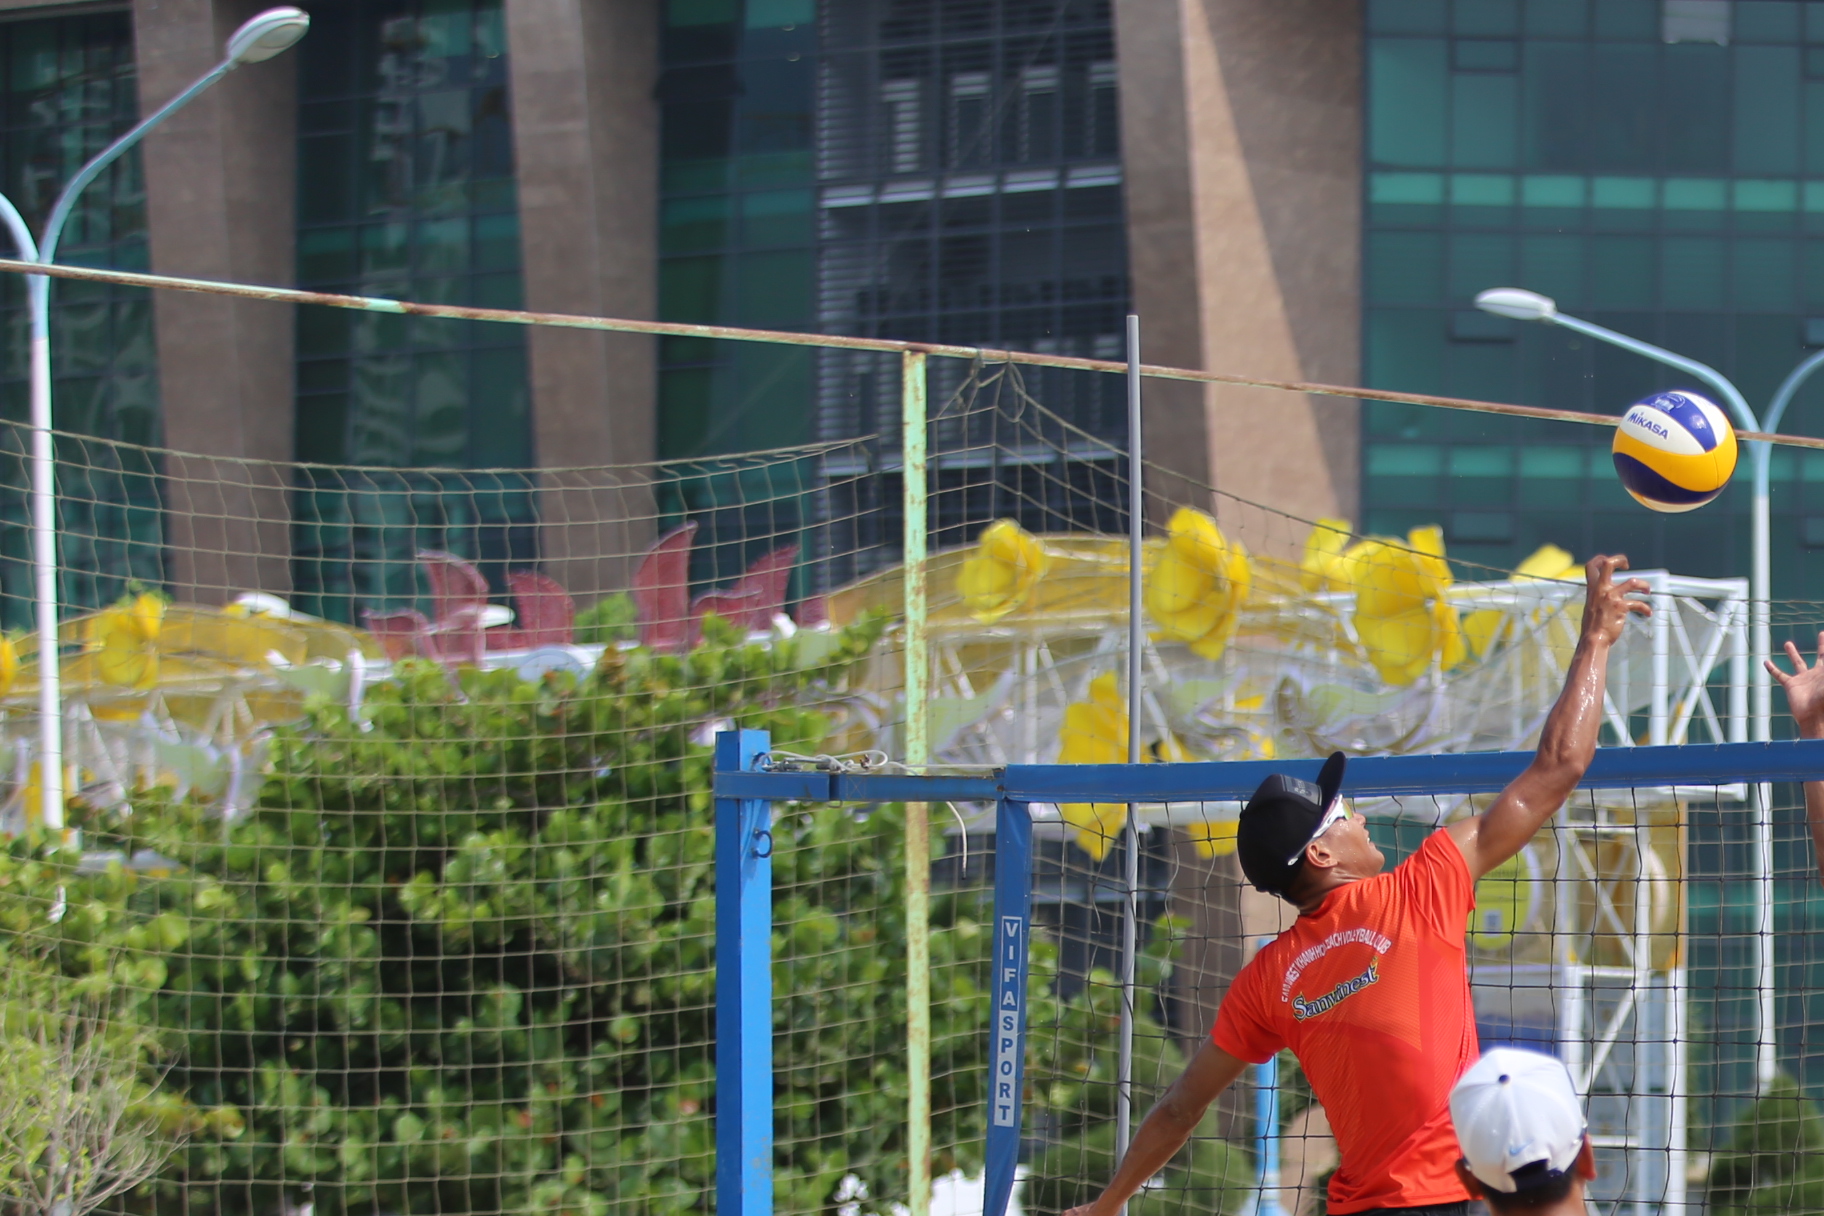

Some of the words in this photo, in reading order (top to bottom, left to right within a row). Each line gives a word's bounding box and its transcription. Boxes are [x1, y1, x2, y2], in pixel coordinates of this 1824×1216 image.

[1627, 411, 1669, 440] MIKASA
[1324, 932, 1343, 949] EACH
[1292, 965, 1379, 1021] Sanvinest
